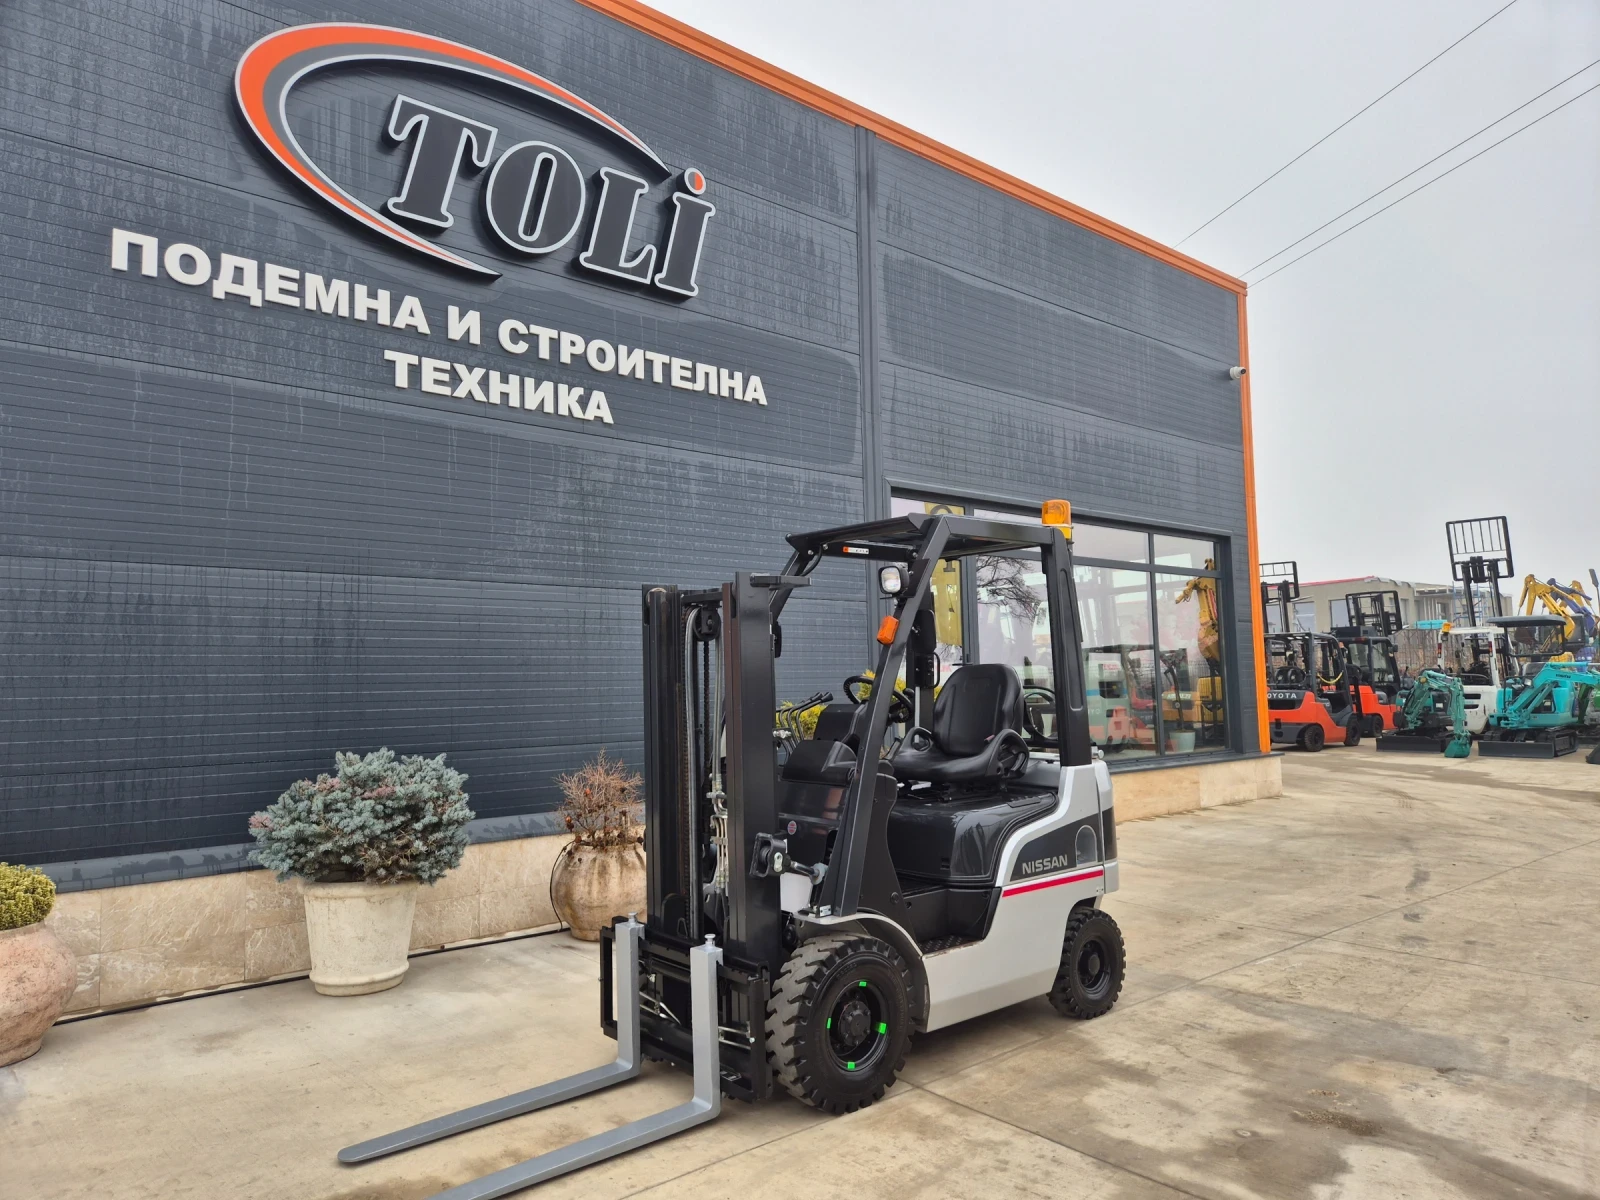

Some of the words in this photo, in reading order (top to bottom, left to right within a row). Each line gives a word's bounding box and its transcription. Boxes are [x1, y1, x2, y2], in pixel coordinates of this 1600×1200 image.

[110, 228, 431, 336] ПОДЕМНА
[446, 305, 482, 346] И
[498, 318, 768, 407] СТРОИТЕЛНА
[384, 350, 614, 425] ТЕХНИКА
[1022, 854, 1068, 875] NISSAN
